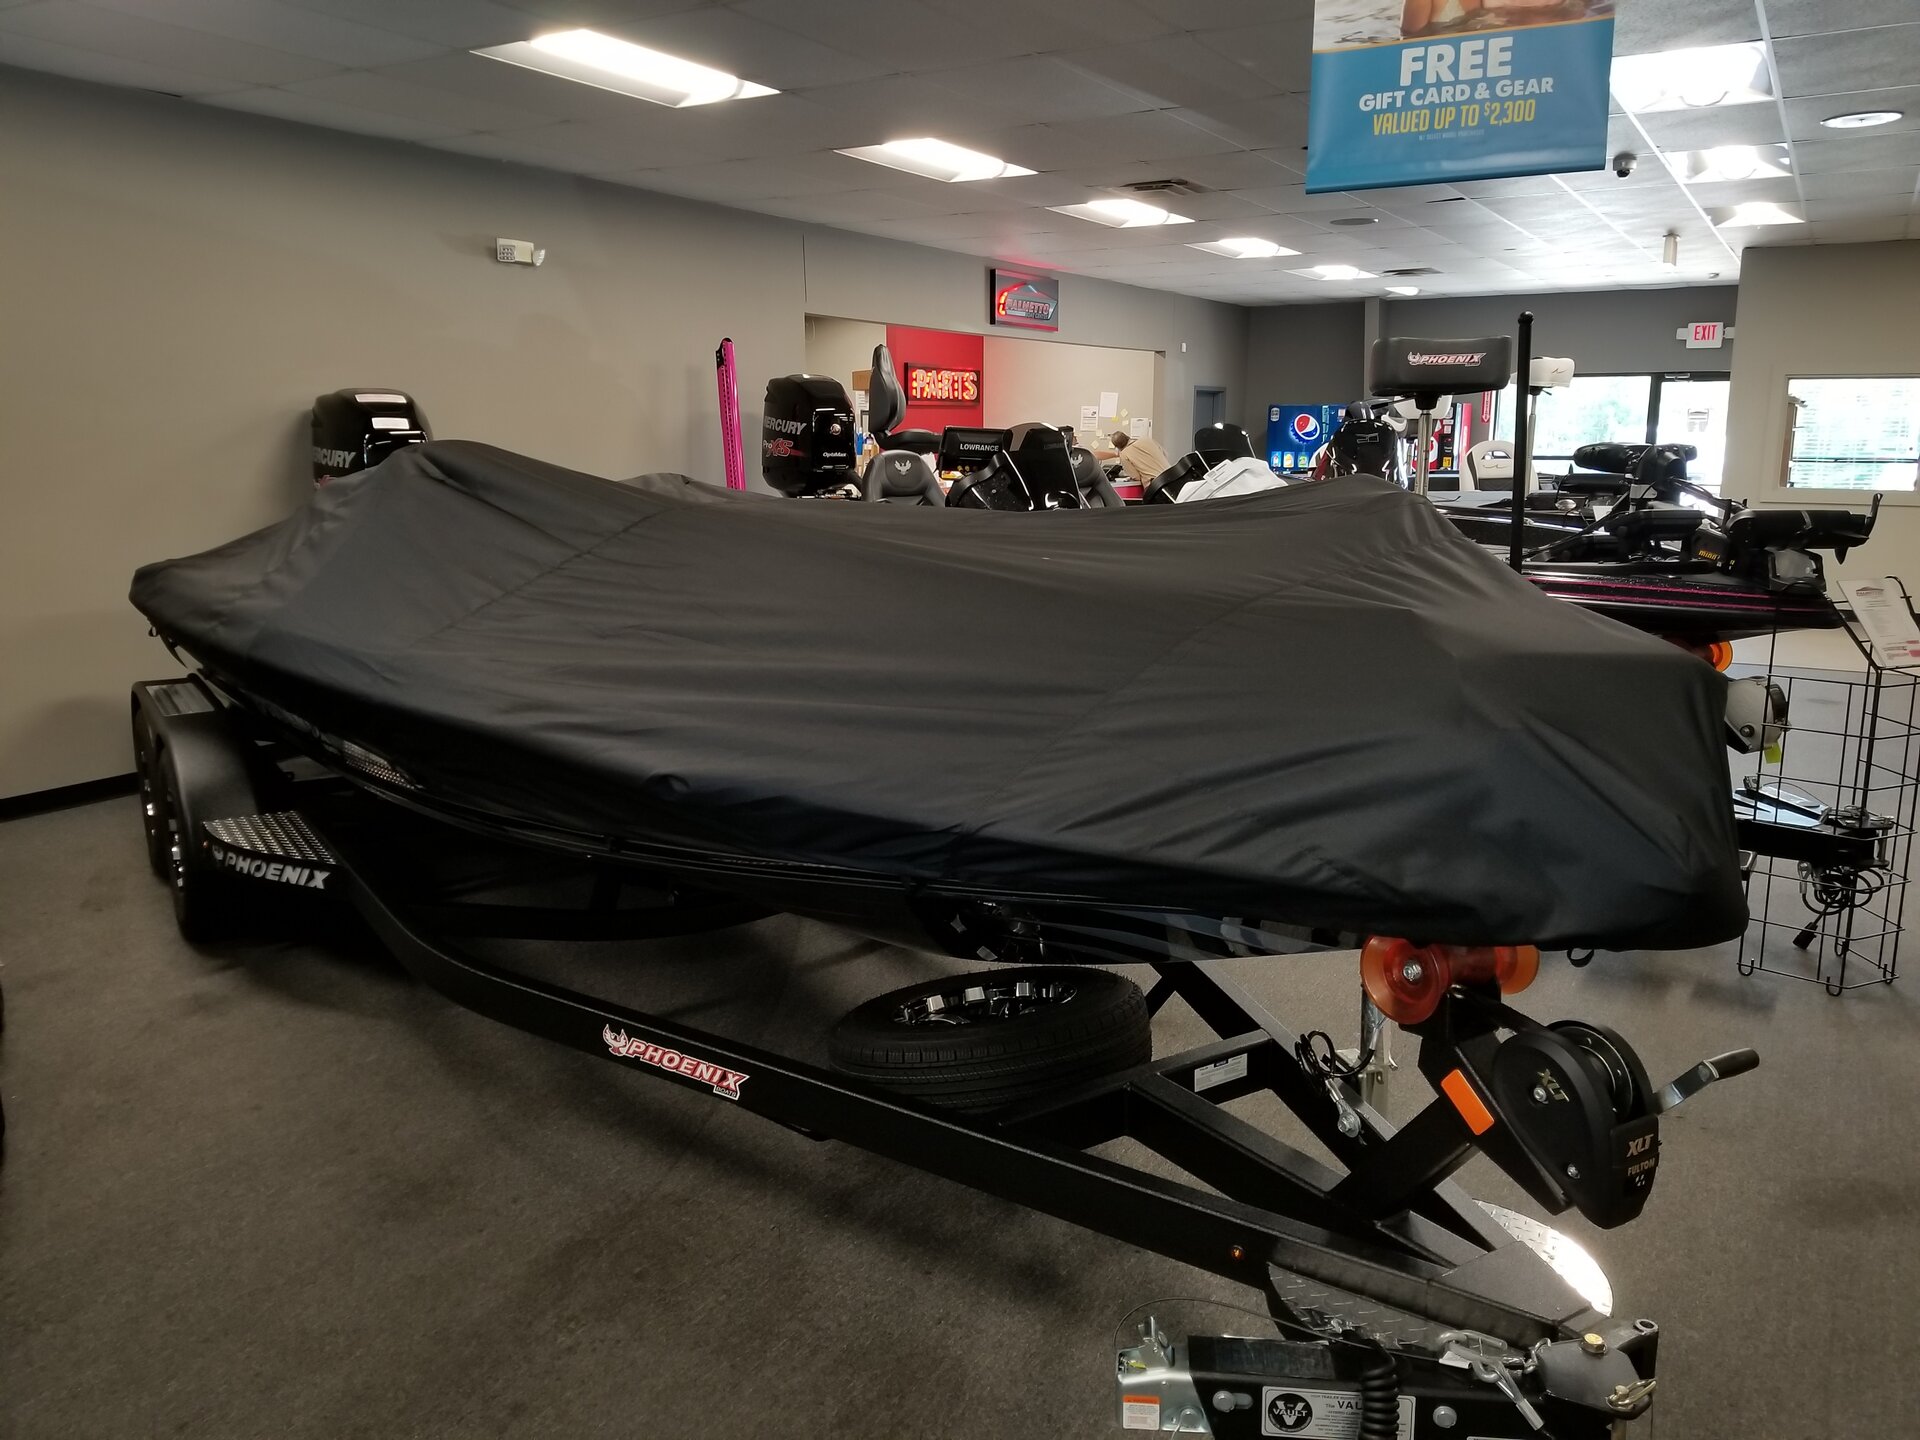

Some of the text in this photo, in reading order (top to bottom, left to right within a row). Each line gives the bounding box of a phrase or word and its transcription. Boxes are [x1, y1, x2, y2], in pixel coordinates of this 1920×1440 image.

[1400, 36, 1513, 87] FREE
[1359, 77, 1554, 112] GIFT CARD & GEAR
[1373, 108, 1430, 136] VALUED
[1433, 106, 1456, 130] UP
[1460, 104, 1480, 128] TO
[1484, 99, 1536, 127] $2,300
[1006, 299, 1050, 315] PALMETTO
[1694, 325, 1717, 340] EXIT
[1420, 352, 1486, 365] PHOENIX
[912, 369, 977, 400] PARTS
[960, 443, 999, 452] LOWRANCE
[225, 851, 331, 890] PHOENIX
[625, 1037, 750, 1091] PHOENIX
[1537, 1068, 1570, 1102] XLT
[1627, 1133, 1654, 1157] XLT
[1627, 1157, 1656, 1177] FULTON
[1273, 1408, 1308, 1417] VAULT
